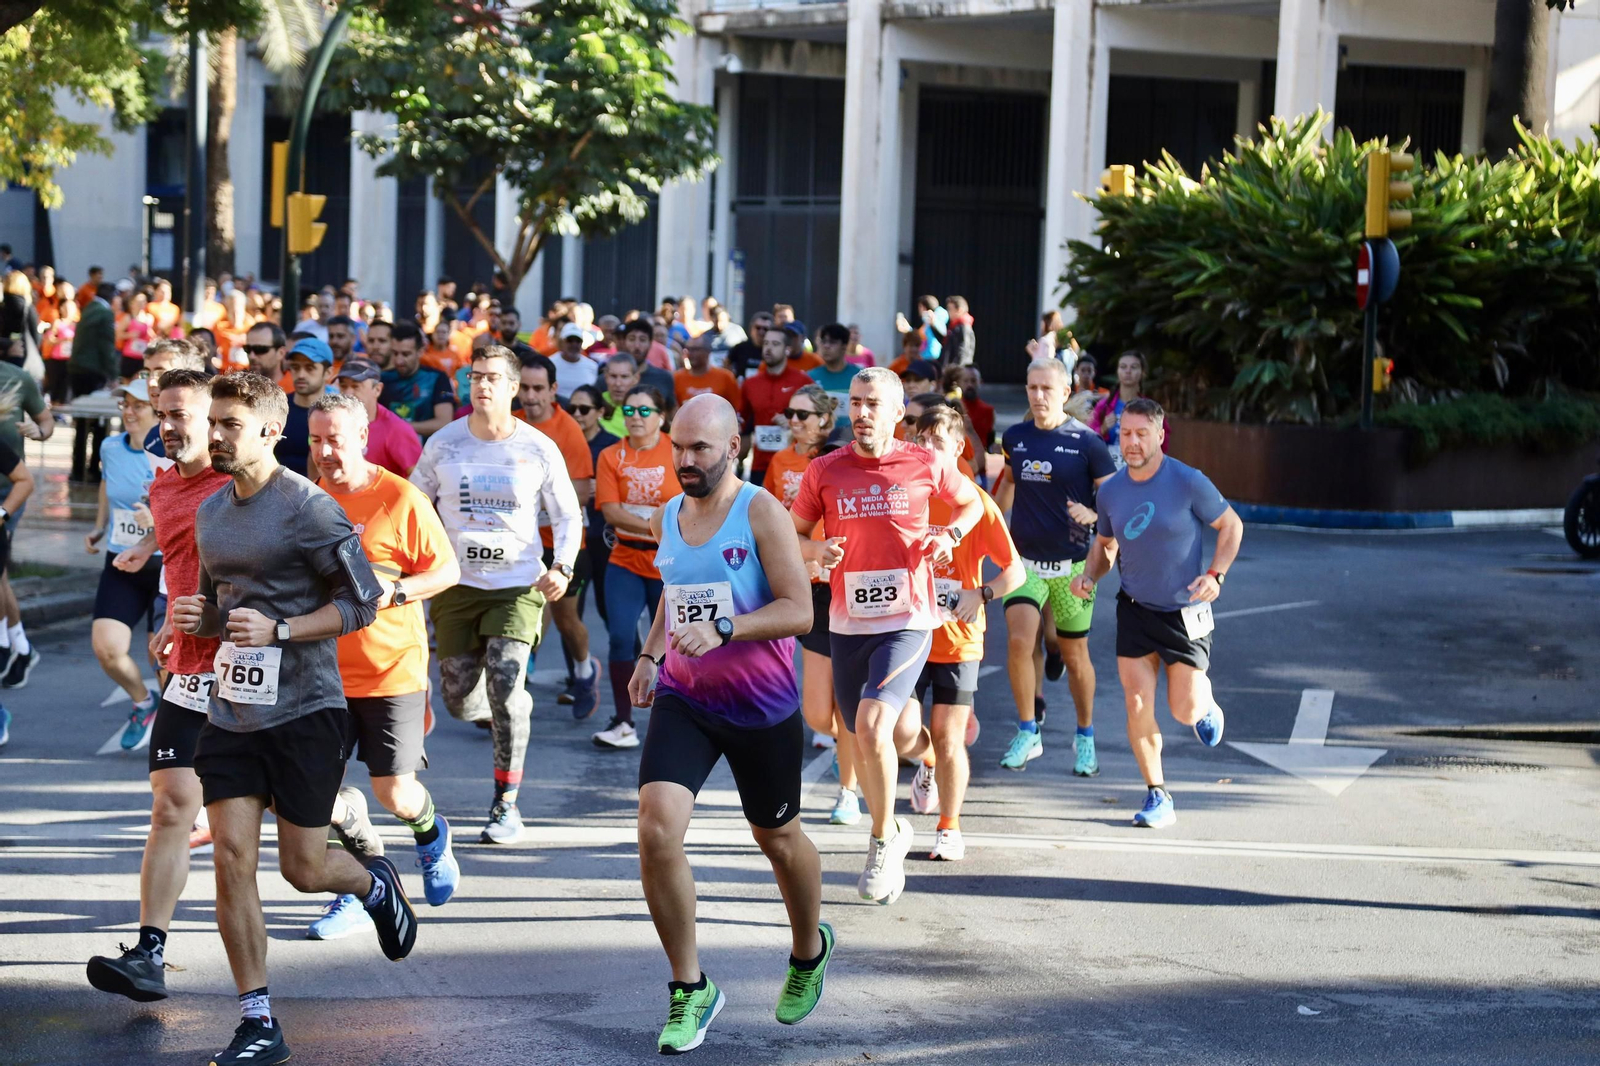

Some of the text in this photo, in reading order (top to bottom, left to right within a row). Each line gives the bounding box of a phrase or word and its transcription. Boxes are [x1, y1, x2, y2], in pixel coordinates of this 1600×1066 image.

[836, 497, 857, 515] IX
[861, 493, 909, 503] MEDIA 2022
[861, 501, 909, 512] MARATÓN
[839, 511, 859, 520] Ciudad
[466, 546, 504, 560] 502
[855, 586, 898, 603] 823
[677, 604, 718, 624] 527
[221, 662, 264, 686] 760
[179, 674, 215, 697] 581
